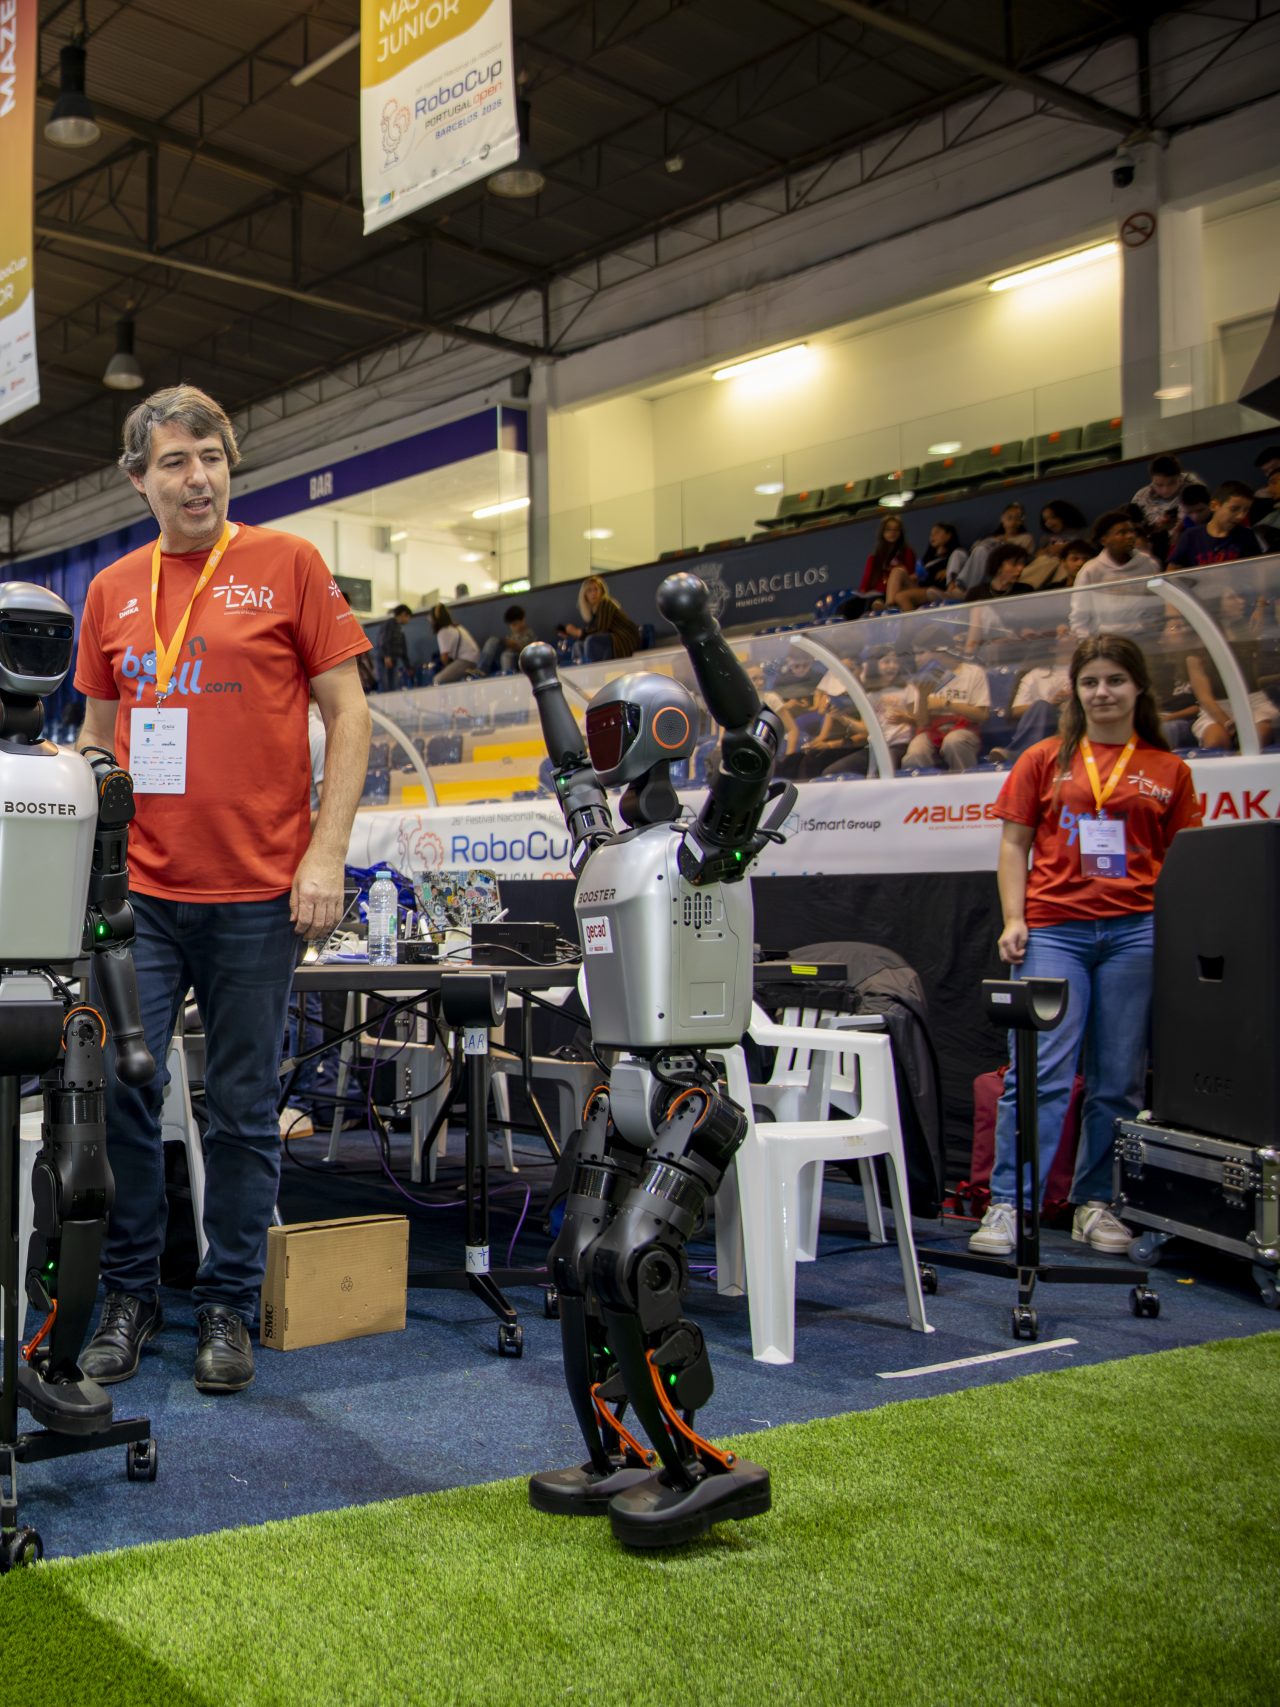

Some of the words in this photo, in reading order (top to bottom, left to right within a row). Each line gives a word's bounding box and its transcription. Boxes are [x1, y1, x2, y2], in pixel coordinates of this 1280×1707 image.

[377, 0, 460, 62] JUNIOR
[0, 0, 17, 118] MAZE
[414, 60, 502, 120] RoboCup
[424, 101, 472, 129] PORTUGAL
[310, 471, 333, 499] BAR
[735, 565, 830, 598] BARCELOS
[4, 801, 76, 816] BOOSTER
[1199, 789, 1280, 821] JAK
[847, 820, 881, 832] Group
[451, 831, 569, 863] RoboCu
[578, 888, 616, 903] BOOSTER
[586, 918, 606, 943] gecad
[265, 1303, 273, 1339] SMC
